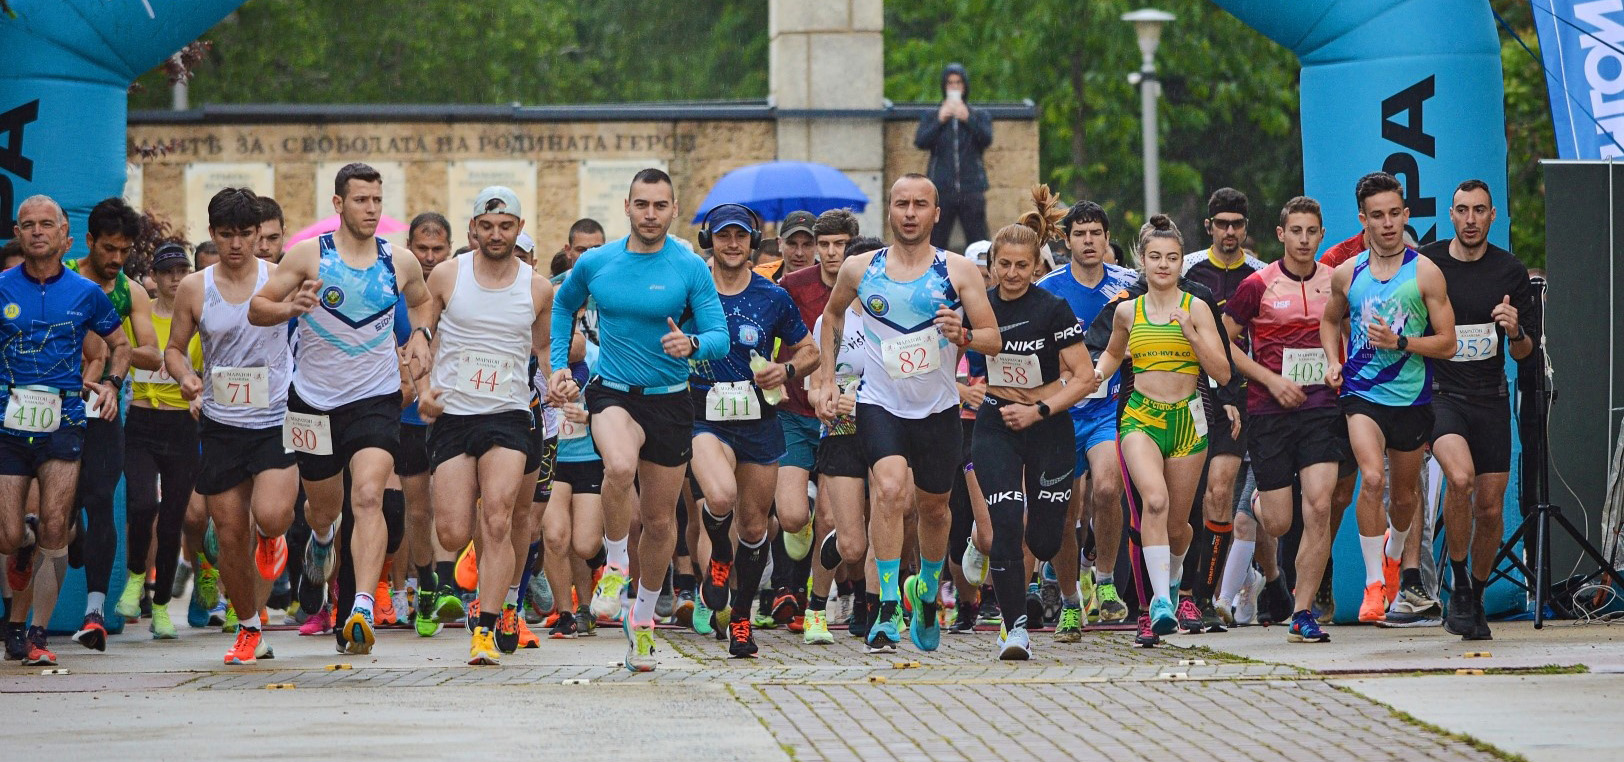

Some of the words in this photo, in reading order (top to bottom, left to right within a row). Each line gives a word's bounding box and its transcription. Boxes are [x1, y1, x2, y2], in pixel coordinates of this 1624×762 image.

[236, 134, 265, 154] ЗА
[436, 136, 469, 152] НА
[1054, 323, 1083, 342] PRO
[1004, 339, 1046, 352] NIKE
[1455, 337, 1492, 358] 252
[899, 347, 930, 374] 82
[469, 368, 499, 392] 44
[1002, 366, 1029, 386] 58
[1288, 362, 1324, 383] 403
[226, 382, 252, 404] 71
[12, 404, 54, 429] 410
[714, 395, 751, 417] 411
[292, 426, 317, 450] 80
[984, 490, 1024, 506] NIKE
[1038, 488, 1072, 503] PRO
